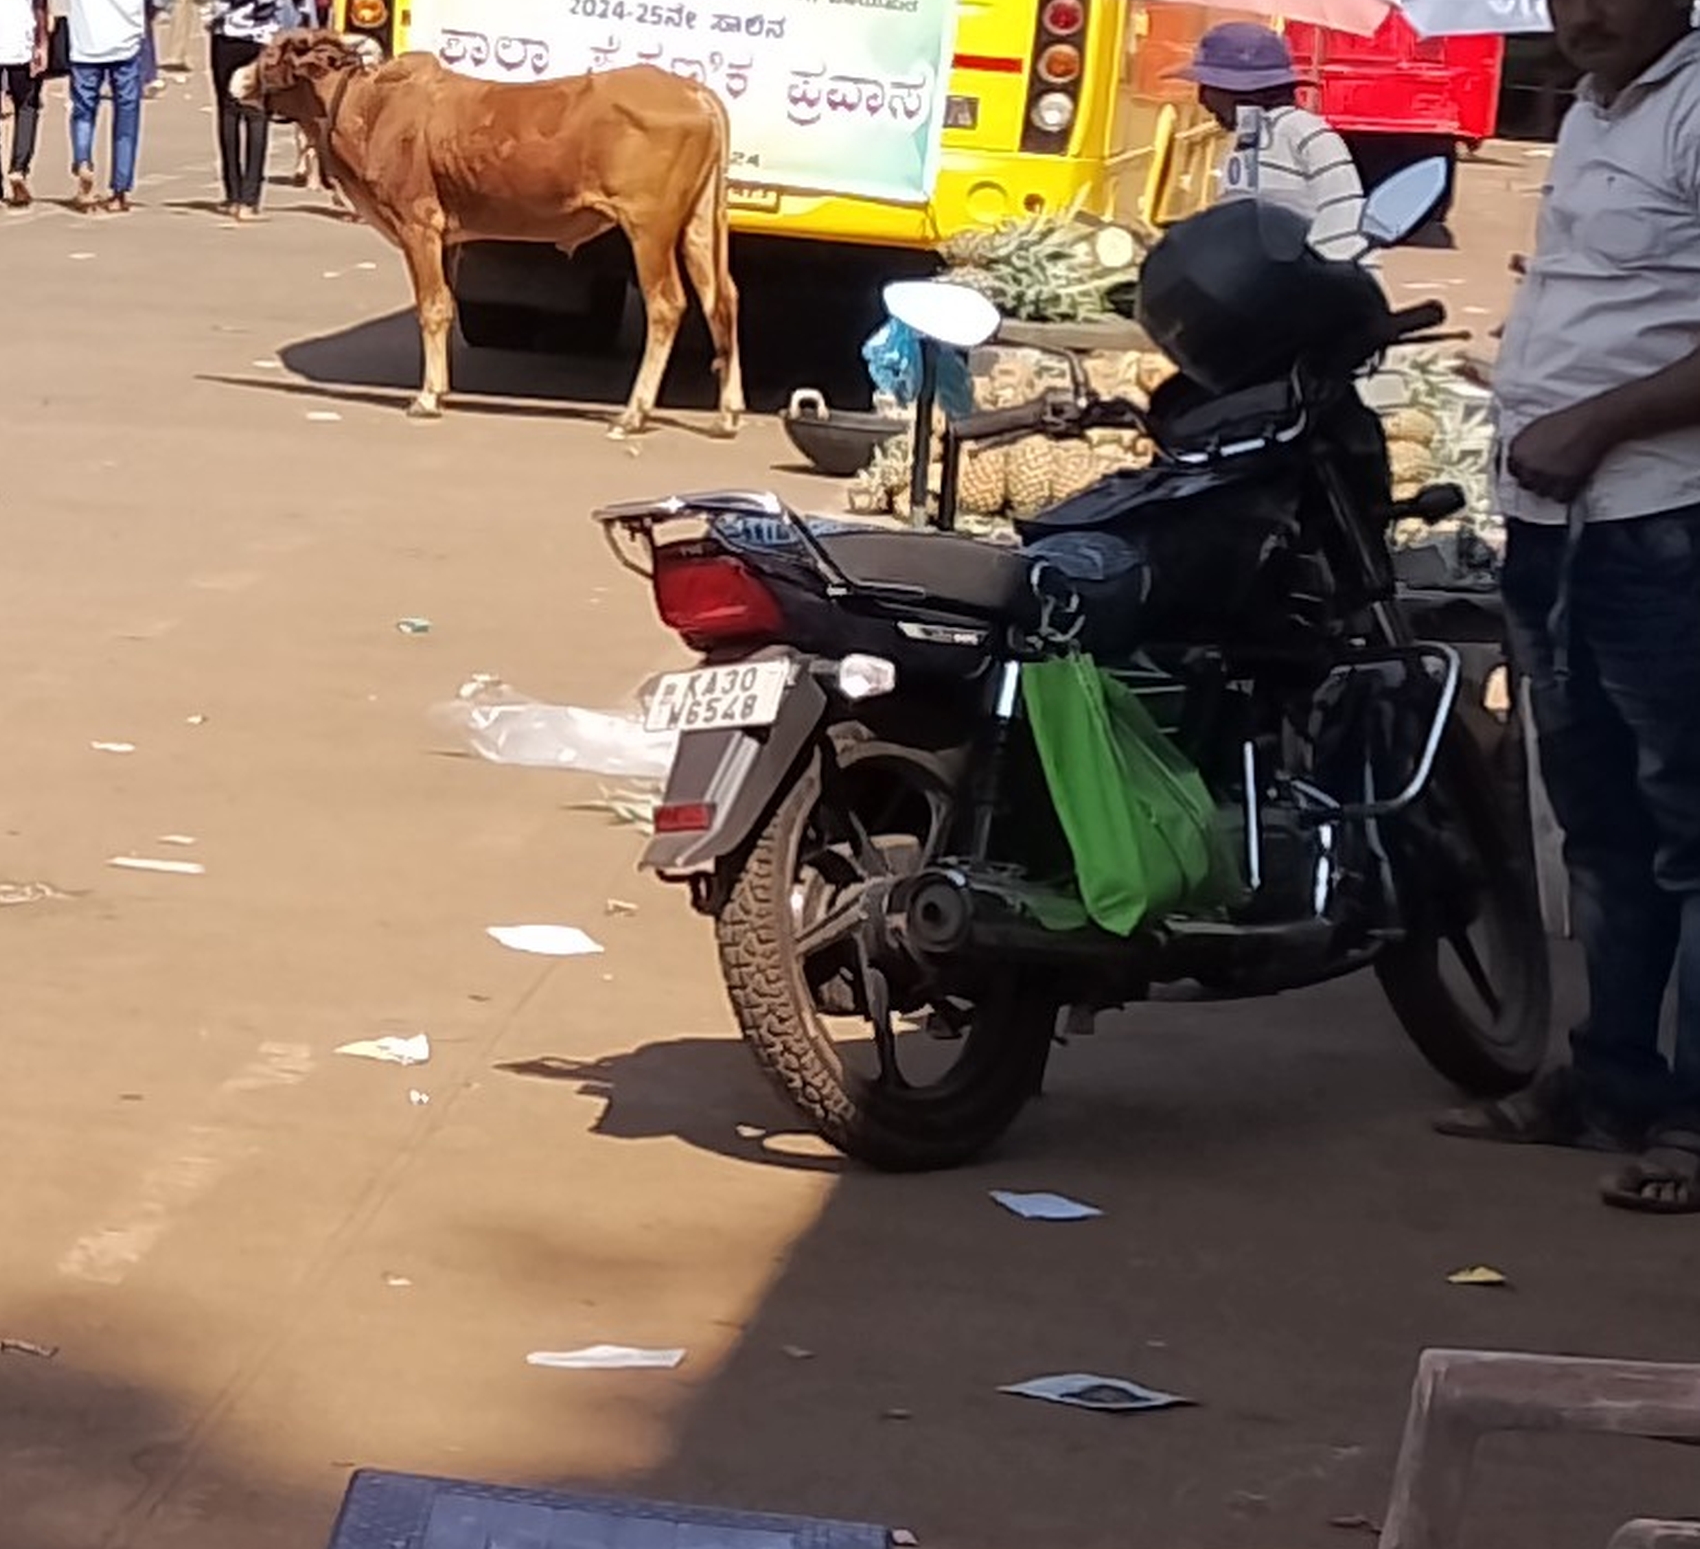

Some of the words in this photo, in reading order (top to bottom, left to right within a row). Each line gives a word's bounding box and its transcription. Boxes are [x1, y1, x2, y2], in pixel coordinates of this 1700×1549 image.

[439, 27, 550, 75] ಶಾಲಾ
[786, 58, 927, 127] ಪ್ರವಾಸ
[687, 666, 758, 700] KA30
